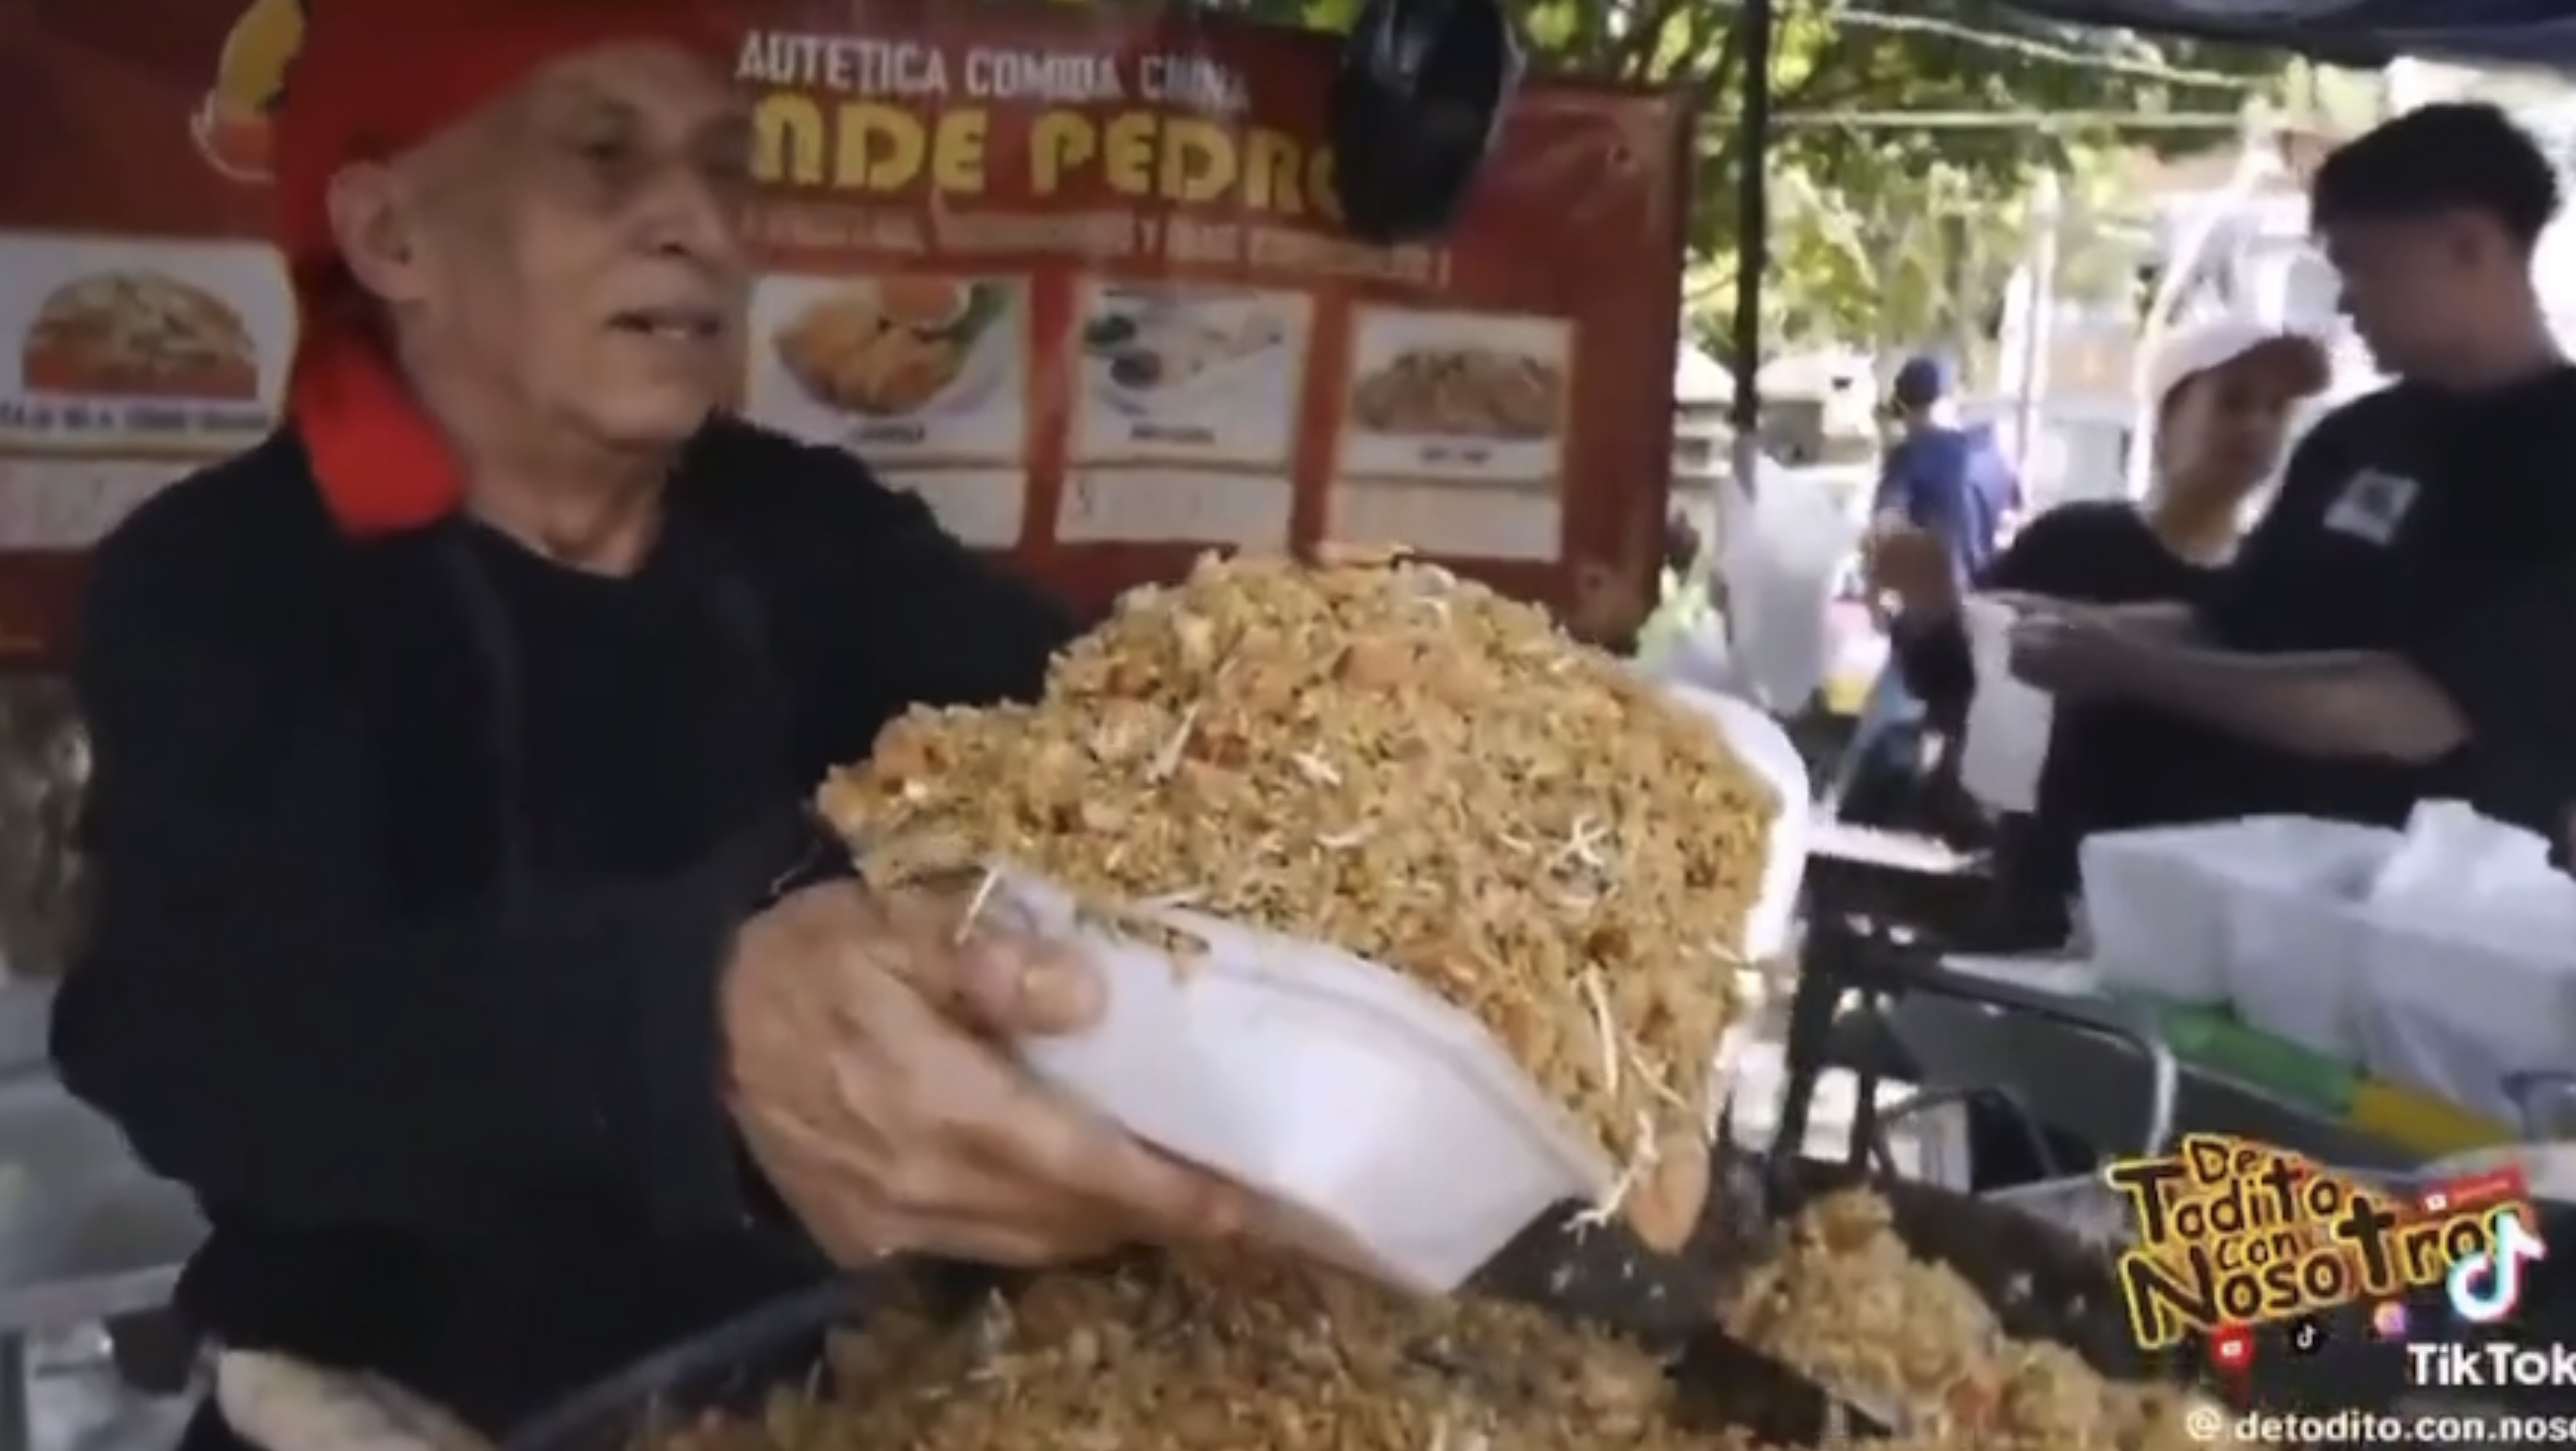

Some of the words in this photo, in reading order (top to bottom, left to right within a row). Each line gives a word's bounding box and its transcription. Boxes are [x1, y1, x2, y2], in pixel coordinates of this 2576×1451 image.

[734, 29, 948, 97] AUTETICA
[965, 44, 1127, 101] COMIDA
[749, 92, 987, 193] NDE
